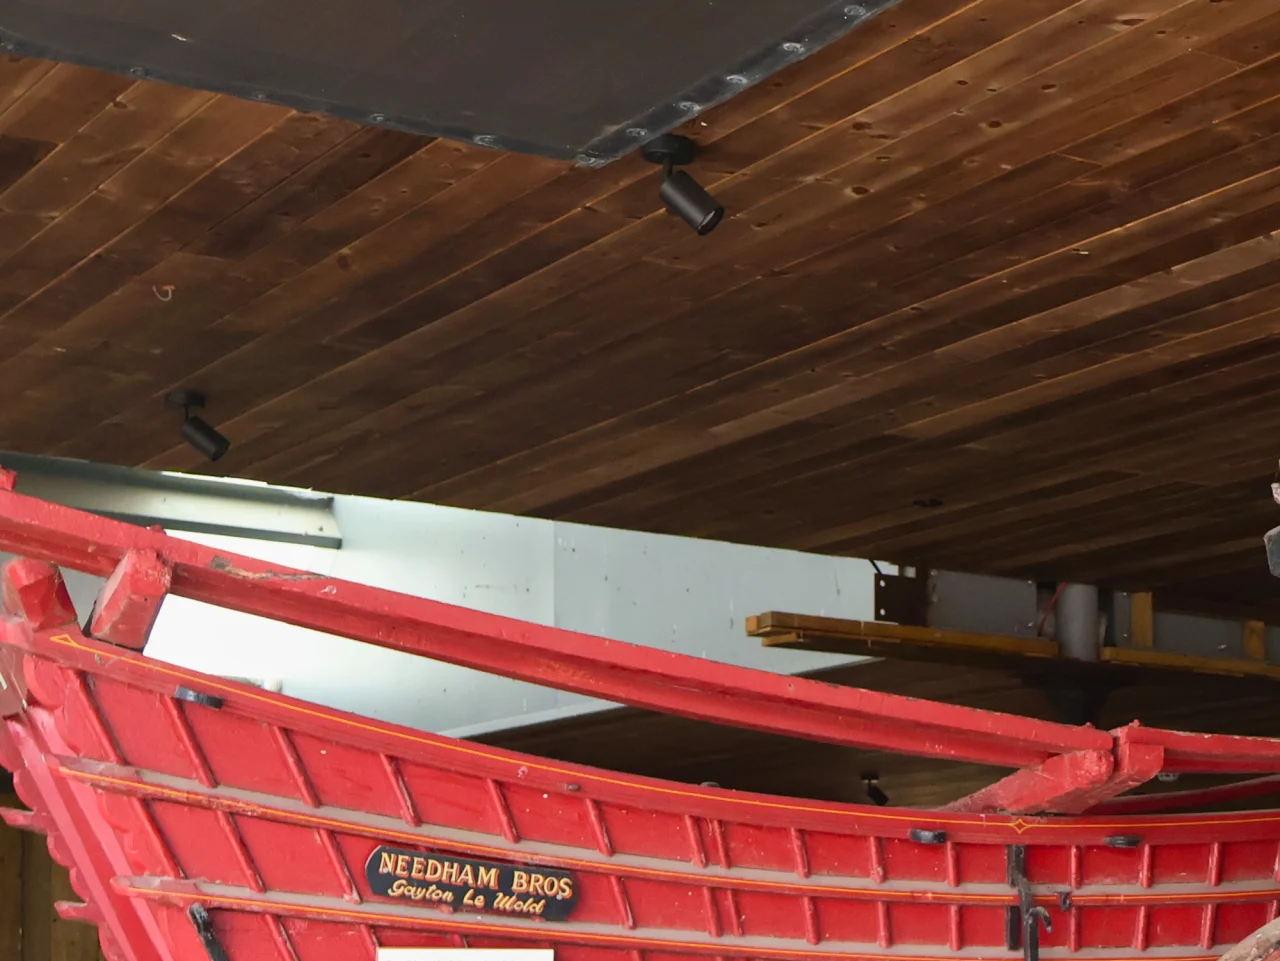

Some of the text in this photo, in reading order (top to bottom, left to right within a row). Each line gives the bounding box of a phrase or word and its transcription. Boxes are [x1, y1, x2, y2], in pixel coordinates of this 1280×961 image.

[379, 852, 573, 900] NEEDHAM BROS
[387, 879, 547, 915] Gayton Le Wold
